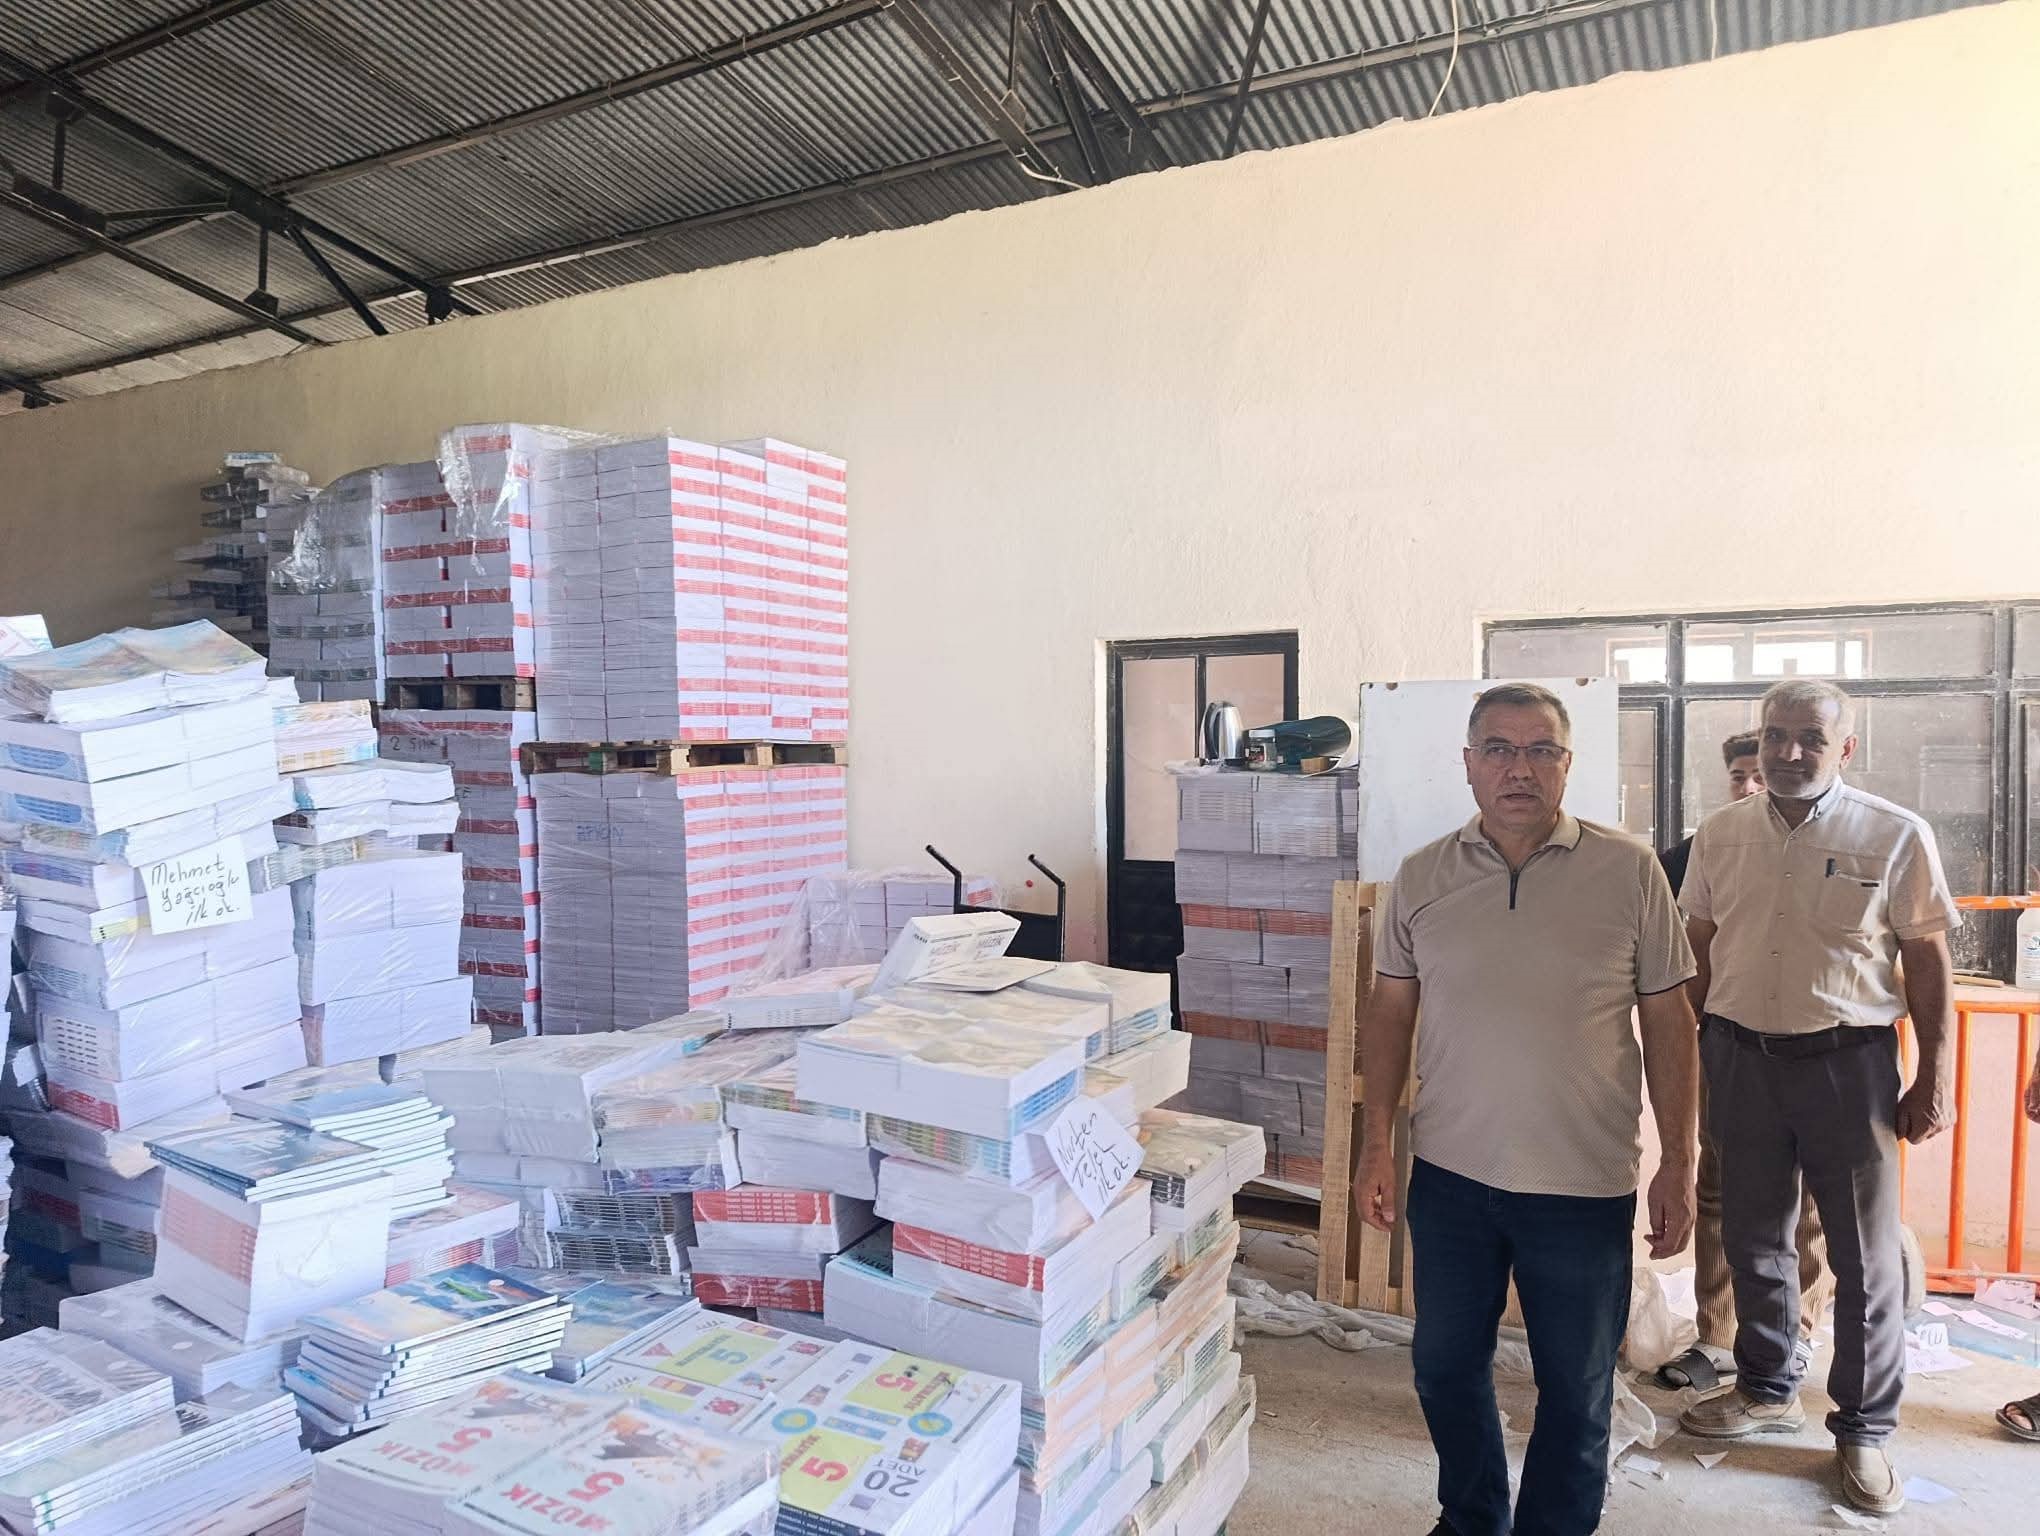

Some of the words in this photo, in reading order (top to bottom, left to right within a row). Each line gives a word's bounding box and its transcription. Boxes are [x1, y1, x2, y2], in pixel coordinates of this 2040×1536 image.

[151, 853, 225, 886] Mehmet
[874, 1372, 918, 1393] 5
[437, 1427, 493, 1454] 5
[800, 1455, 849, 1482] 5
[872, 1458, 927, 1476] ADET
[567, 1471, 625, 1502] 5
[863, 1469, 920, 1498] 20
